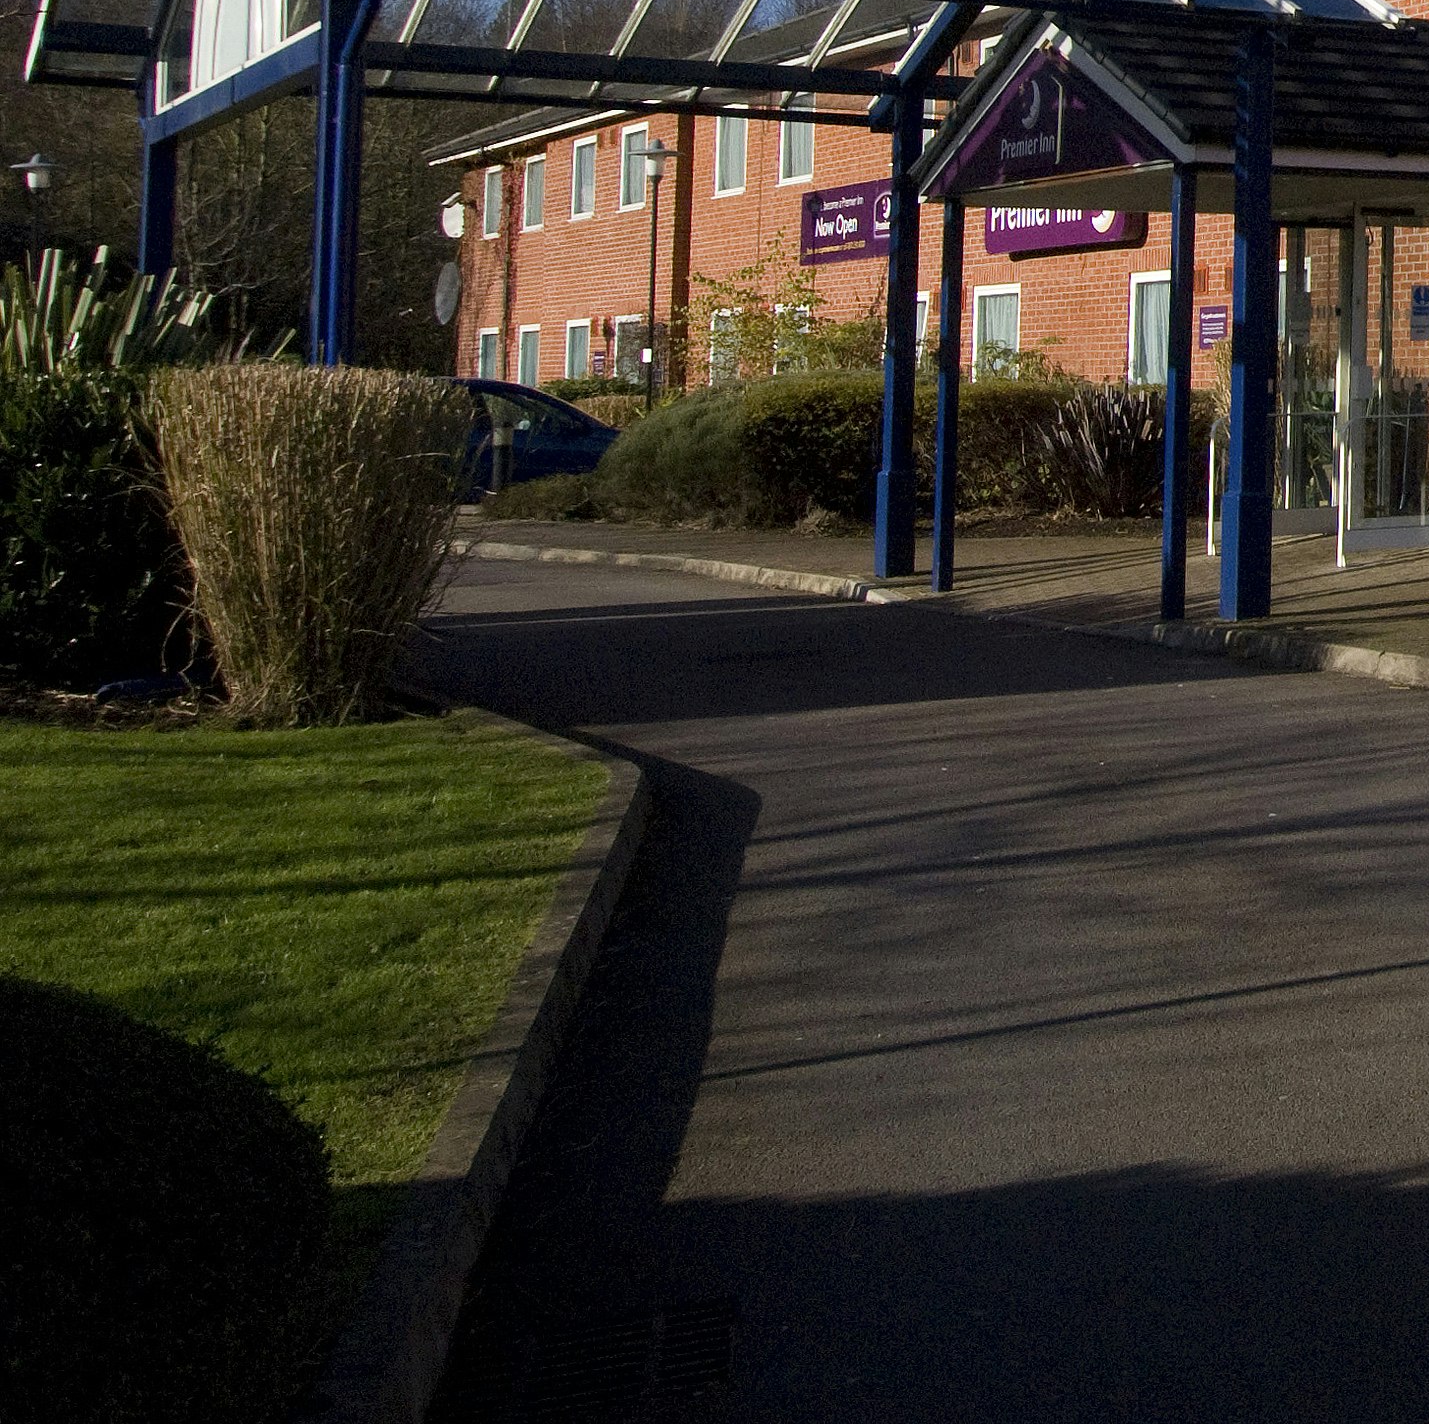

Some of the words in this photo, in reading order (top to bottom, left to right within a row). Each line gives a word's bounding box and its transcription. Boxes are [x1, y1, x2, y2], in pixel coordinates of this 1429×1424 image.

[1001, 138, 1039, 160] Premier
[1040, 133, 1055, 153] Inn
[815, 218, 835, 237] Now
[836, 214, 858, 239] Open
